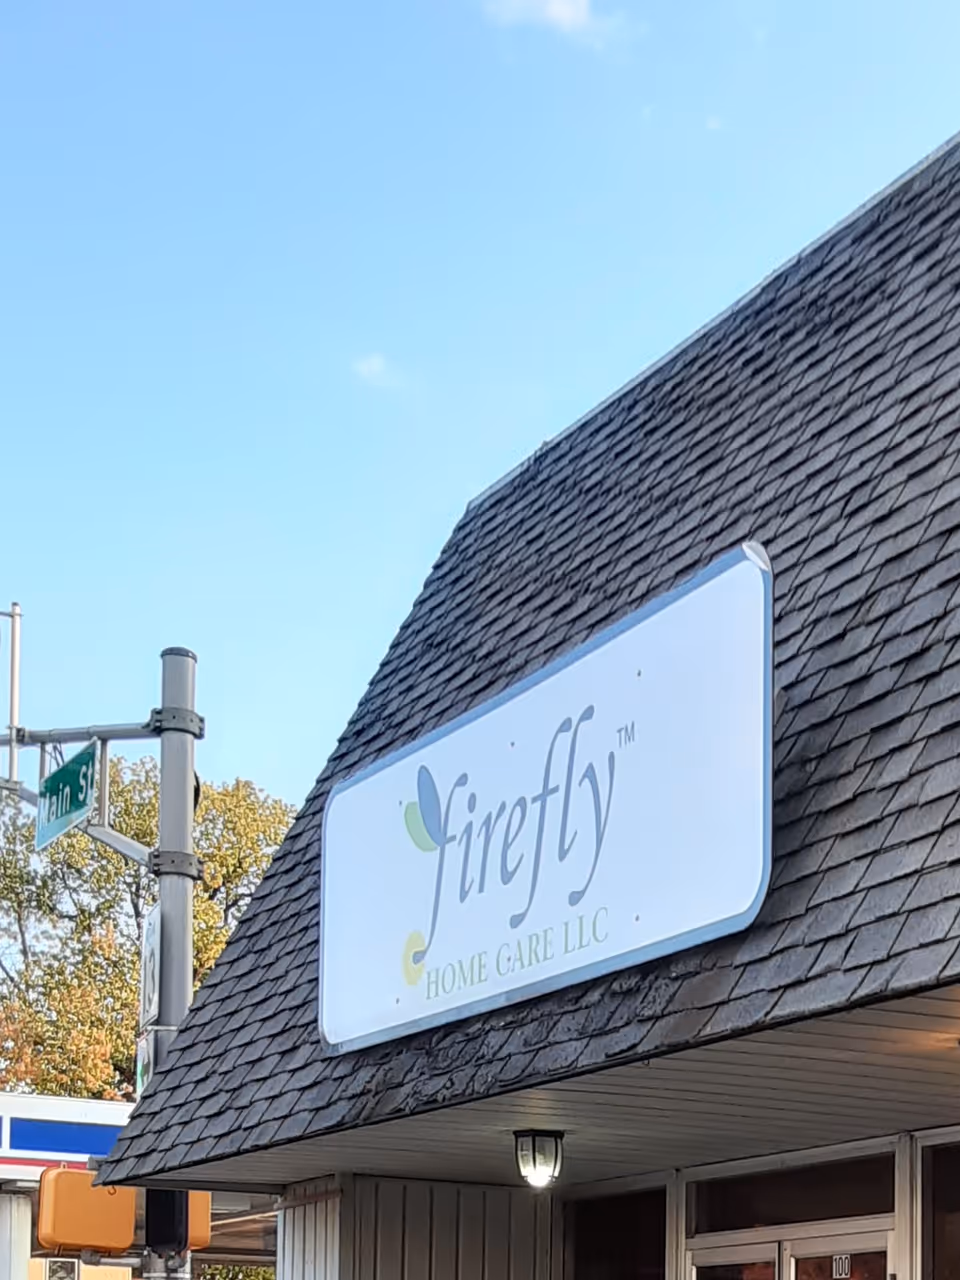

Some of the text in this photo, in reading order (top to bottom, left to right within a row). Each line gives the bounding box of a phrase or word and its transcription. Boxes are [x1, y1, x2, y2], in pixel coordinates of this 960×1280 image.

[39, 760, 94, 829] Main St
[412, 704, 615, 965] firefly
[426, 906, 609, 1001] HOME CARE LLC
[834, 1256, 850, 1277] 100
